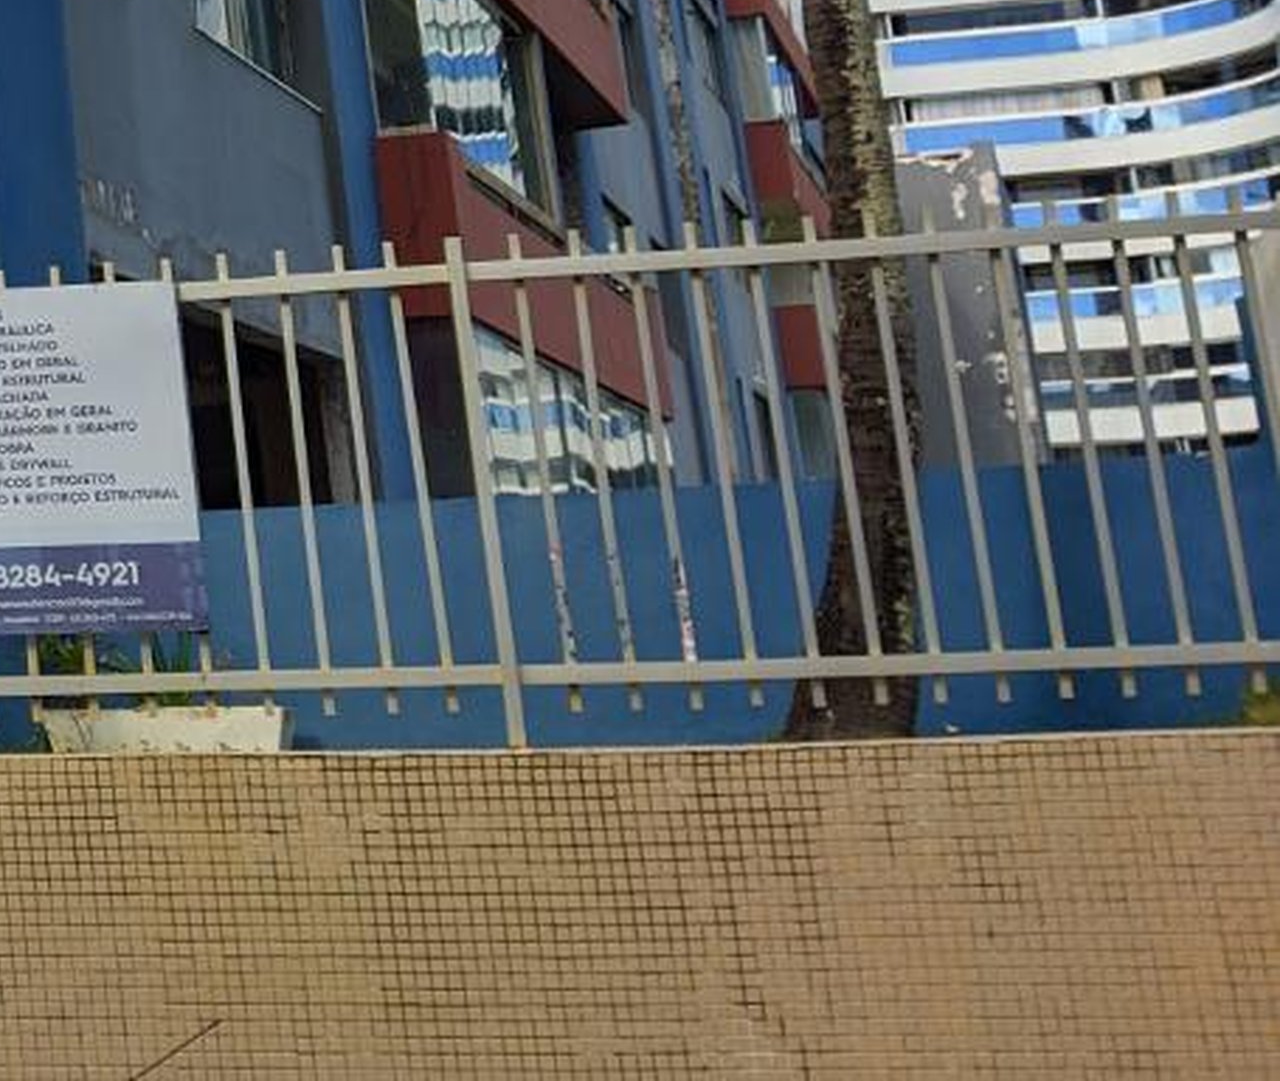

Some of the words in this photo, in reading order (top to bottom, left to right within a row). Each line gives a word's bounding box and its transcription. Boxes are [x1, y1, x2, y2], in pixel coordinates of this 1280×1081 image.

[11, 358, 32, 370] EM
[46, 406, 66, 419] EM
[70, 405, 113, 418] GERAL
[94, 488, 180, 503] ESTRUTURAL
